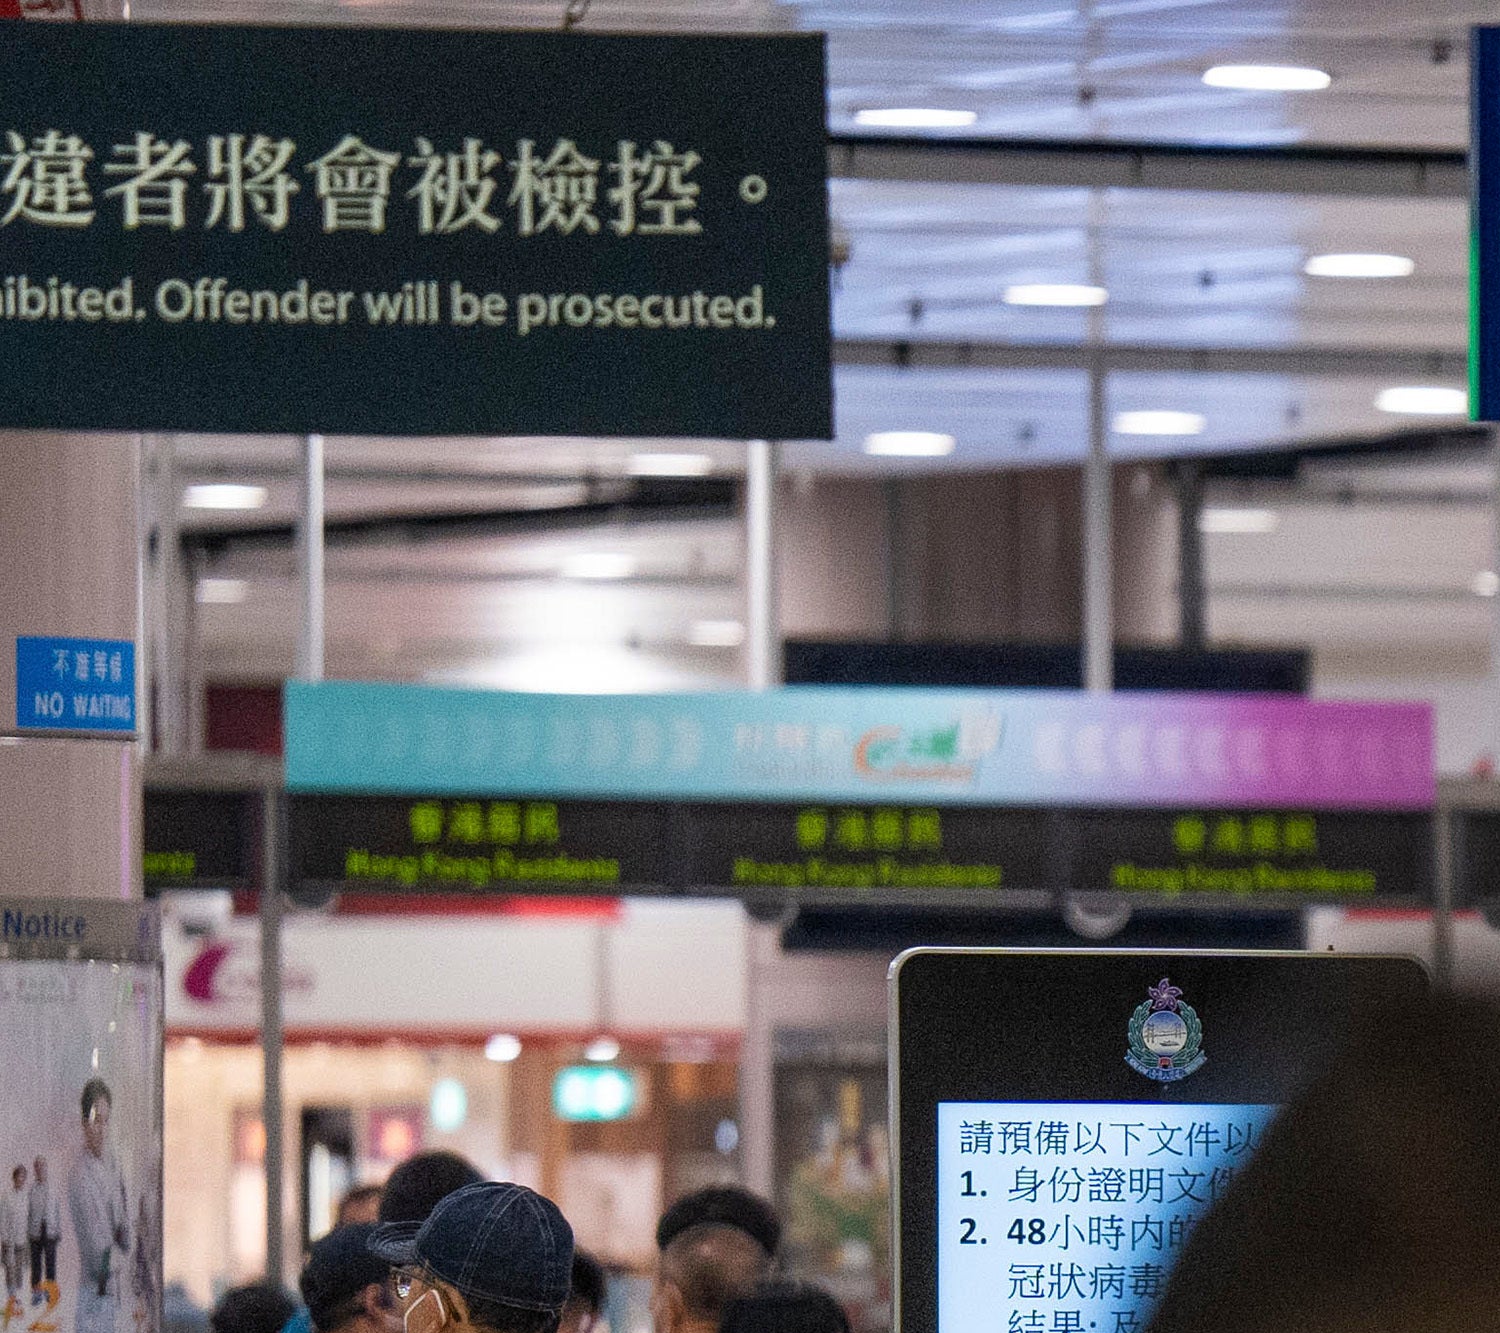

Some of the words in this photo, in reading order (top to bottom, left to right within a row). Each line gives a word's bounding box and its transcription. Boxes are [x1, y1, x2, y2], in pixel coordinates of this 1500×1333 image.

[2, 128, 769, 237] 違者將會被檢控。
[0, 275, 147, 325] ibited.
[155, 277, 355, 326] Offender
[367, 280, 441, 328] will
[451, 282, 506, 328] be
[517, 283, 776, 335] prosecuted.
[34, 691, 65, 719] NO
[72, 694, 132, 721] WAITING
[2, 909, 87, 940] Notice
[960, 1170, 988, 1198] 1.
[959, 1217, 988, 1245] 2.
